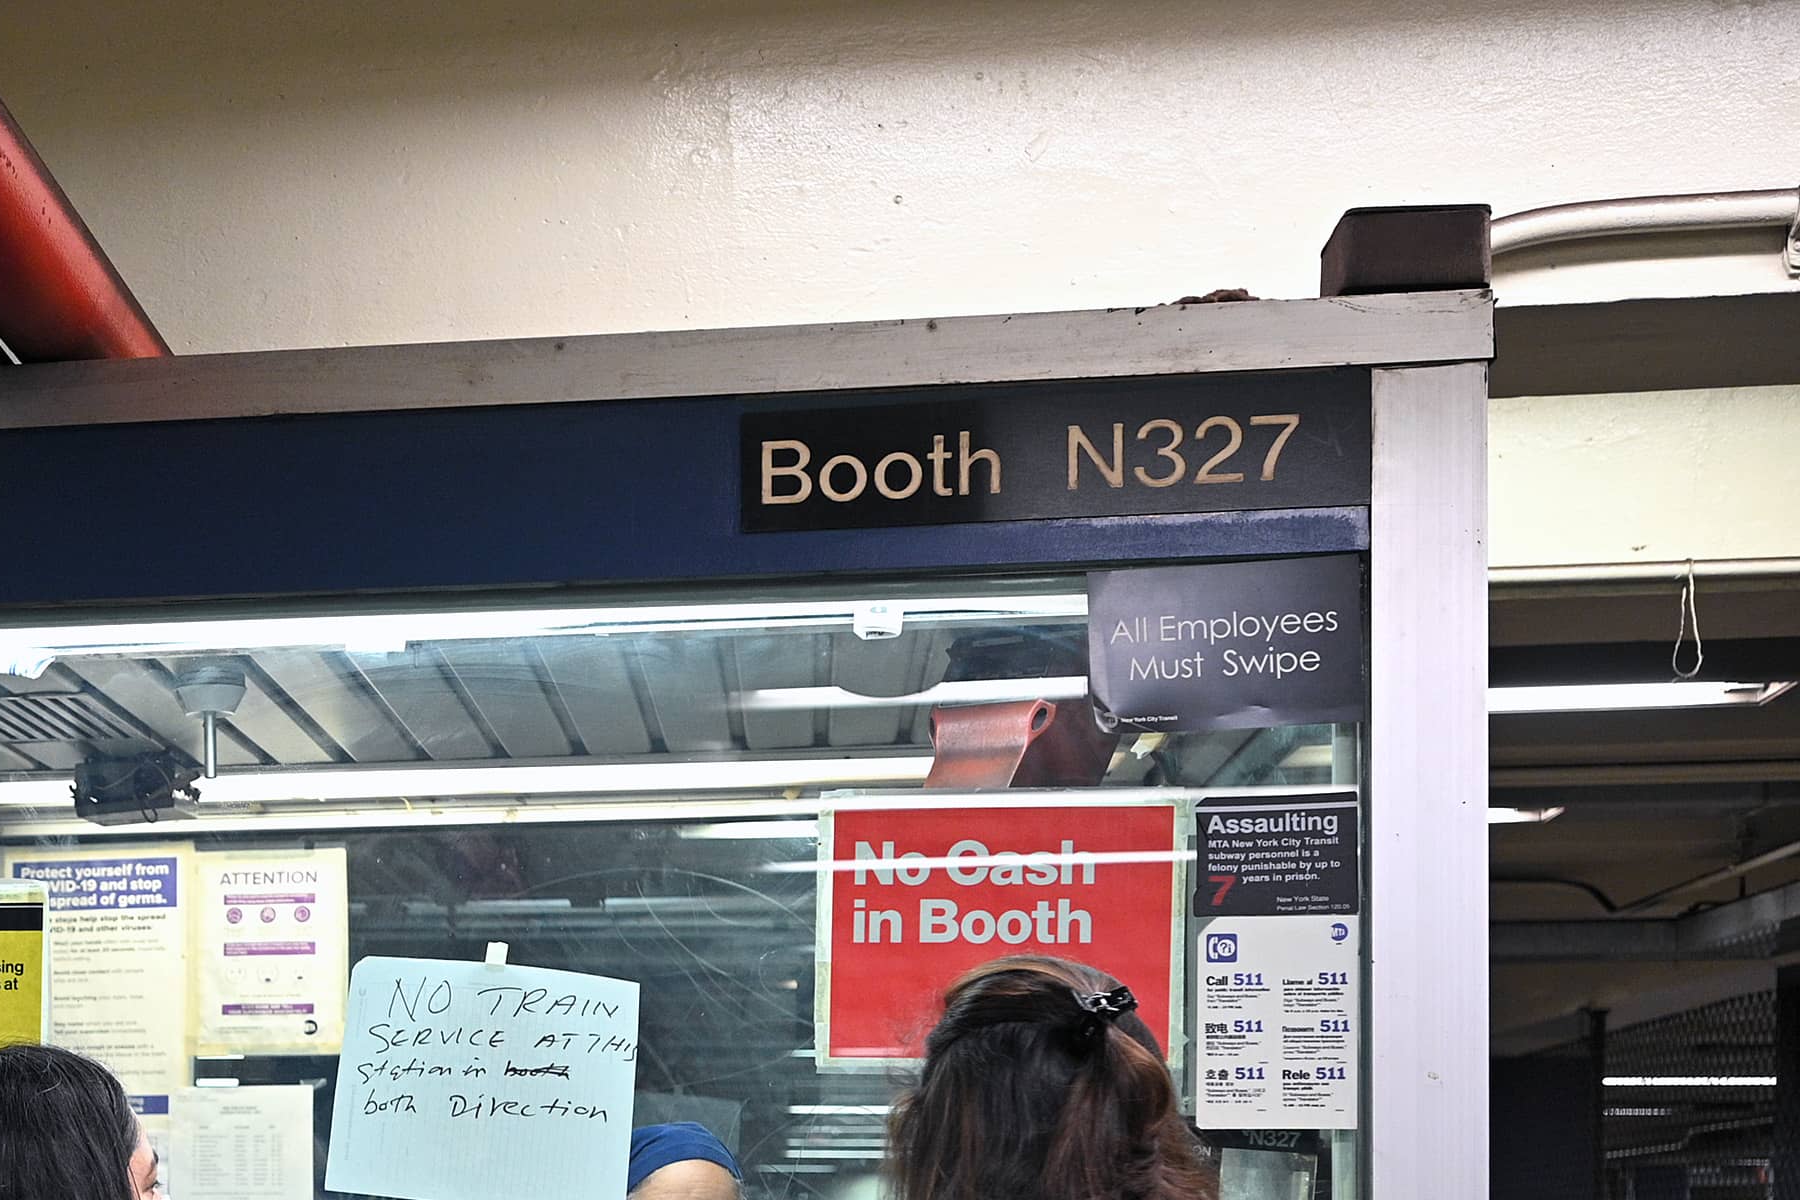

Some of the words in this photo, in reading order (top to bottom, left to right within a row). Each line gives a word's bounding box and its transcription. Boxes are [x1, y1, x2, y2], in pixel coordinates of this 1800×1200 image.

[761, 430, 1001, 505] Booth
[1067, 413, 1301, 491] N327
[1110, 616, 1148, 646] All
[1159, 610, 1338, 646] Employees
[1129, 651, 1205, 681] Must
[1222, 646, 1321, 679] Swipe
[1207, 811, 1338, 836] Assaulting
[1207, 839, 1230, 849] MTA
[1231, 839, 1254, 848] New
[1255, 838, 1279, 847] York
[1280, 838, 1301, 849] City
[1303, 836, 1339, 846] Transit
[853, 840, 931, 887] No
[946, 838, 1095, 887] Cash
[1207, 851, 1246, 862] subway
[1248, 849, 1299, 861] personnel
[1301, 849, 1312, 857] is
[20, 866, 73, 880] Protect
[75, 864, 133, 880] yourself
[134, 863, 170, 876] from
[1207, 863, 1239, 873] felony
[1241, 860, 1297, 872] punishable
[1299, 860, 1311, 872] by
[1314, 861, 1328, 870] up
[1330, 860, 1341, 868] to
[49, 880, 98, 893] VID-19
[99, 879, 128, 892] and
[130, 878, 162, 892] stop
[220, 872, 317, 885] ATTENTION
[1207, 875, 1237, 907] 7
[1242, 874, 1270, 885] years
[1272, 872, 1283, 882] in
[1284, 872, 1321, 884] prison.
[50, 894, 98, 909] spread
[99, 893, 116, 906] of
[117, 893, 168, 908] germs.
[853, 898, 903, 944] in
[919, 898, 1092, 945] Booth
[3, 977, 18, 990] at
[1205, 975, 1229, 986] Call
[1233, 972, 1264, 986] 511
[1318, 971, 1349, 985] 511
[388, 976, 452, 1022] NO
[477, 987, 619, 1019] TRAIN
[1233, 1020, 1264, 1033] 511
[1320, 1019, 1351, 1033] 511
[368, 1022, 505, 1054] SERVICE
[533, 1032, 580, 1050] AT
[357, 1058, 452, 1085] station
[462, 1056, 487, 1079] in
[1234, 1067, 1265, 1080] 511
[1282, 1069, 1311, 1080] Rele
[1315, 1067, 1347, 1080] 511
[364, 1088, 417, 1115] both
[450, 1094, 608, 1123] Direction
[1248, 1130, 1301, 1148] N327
